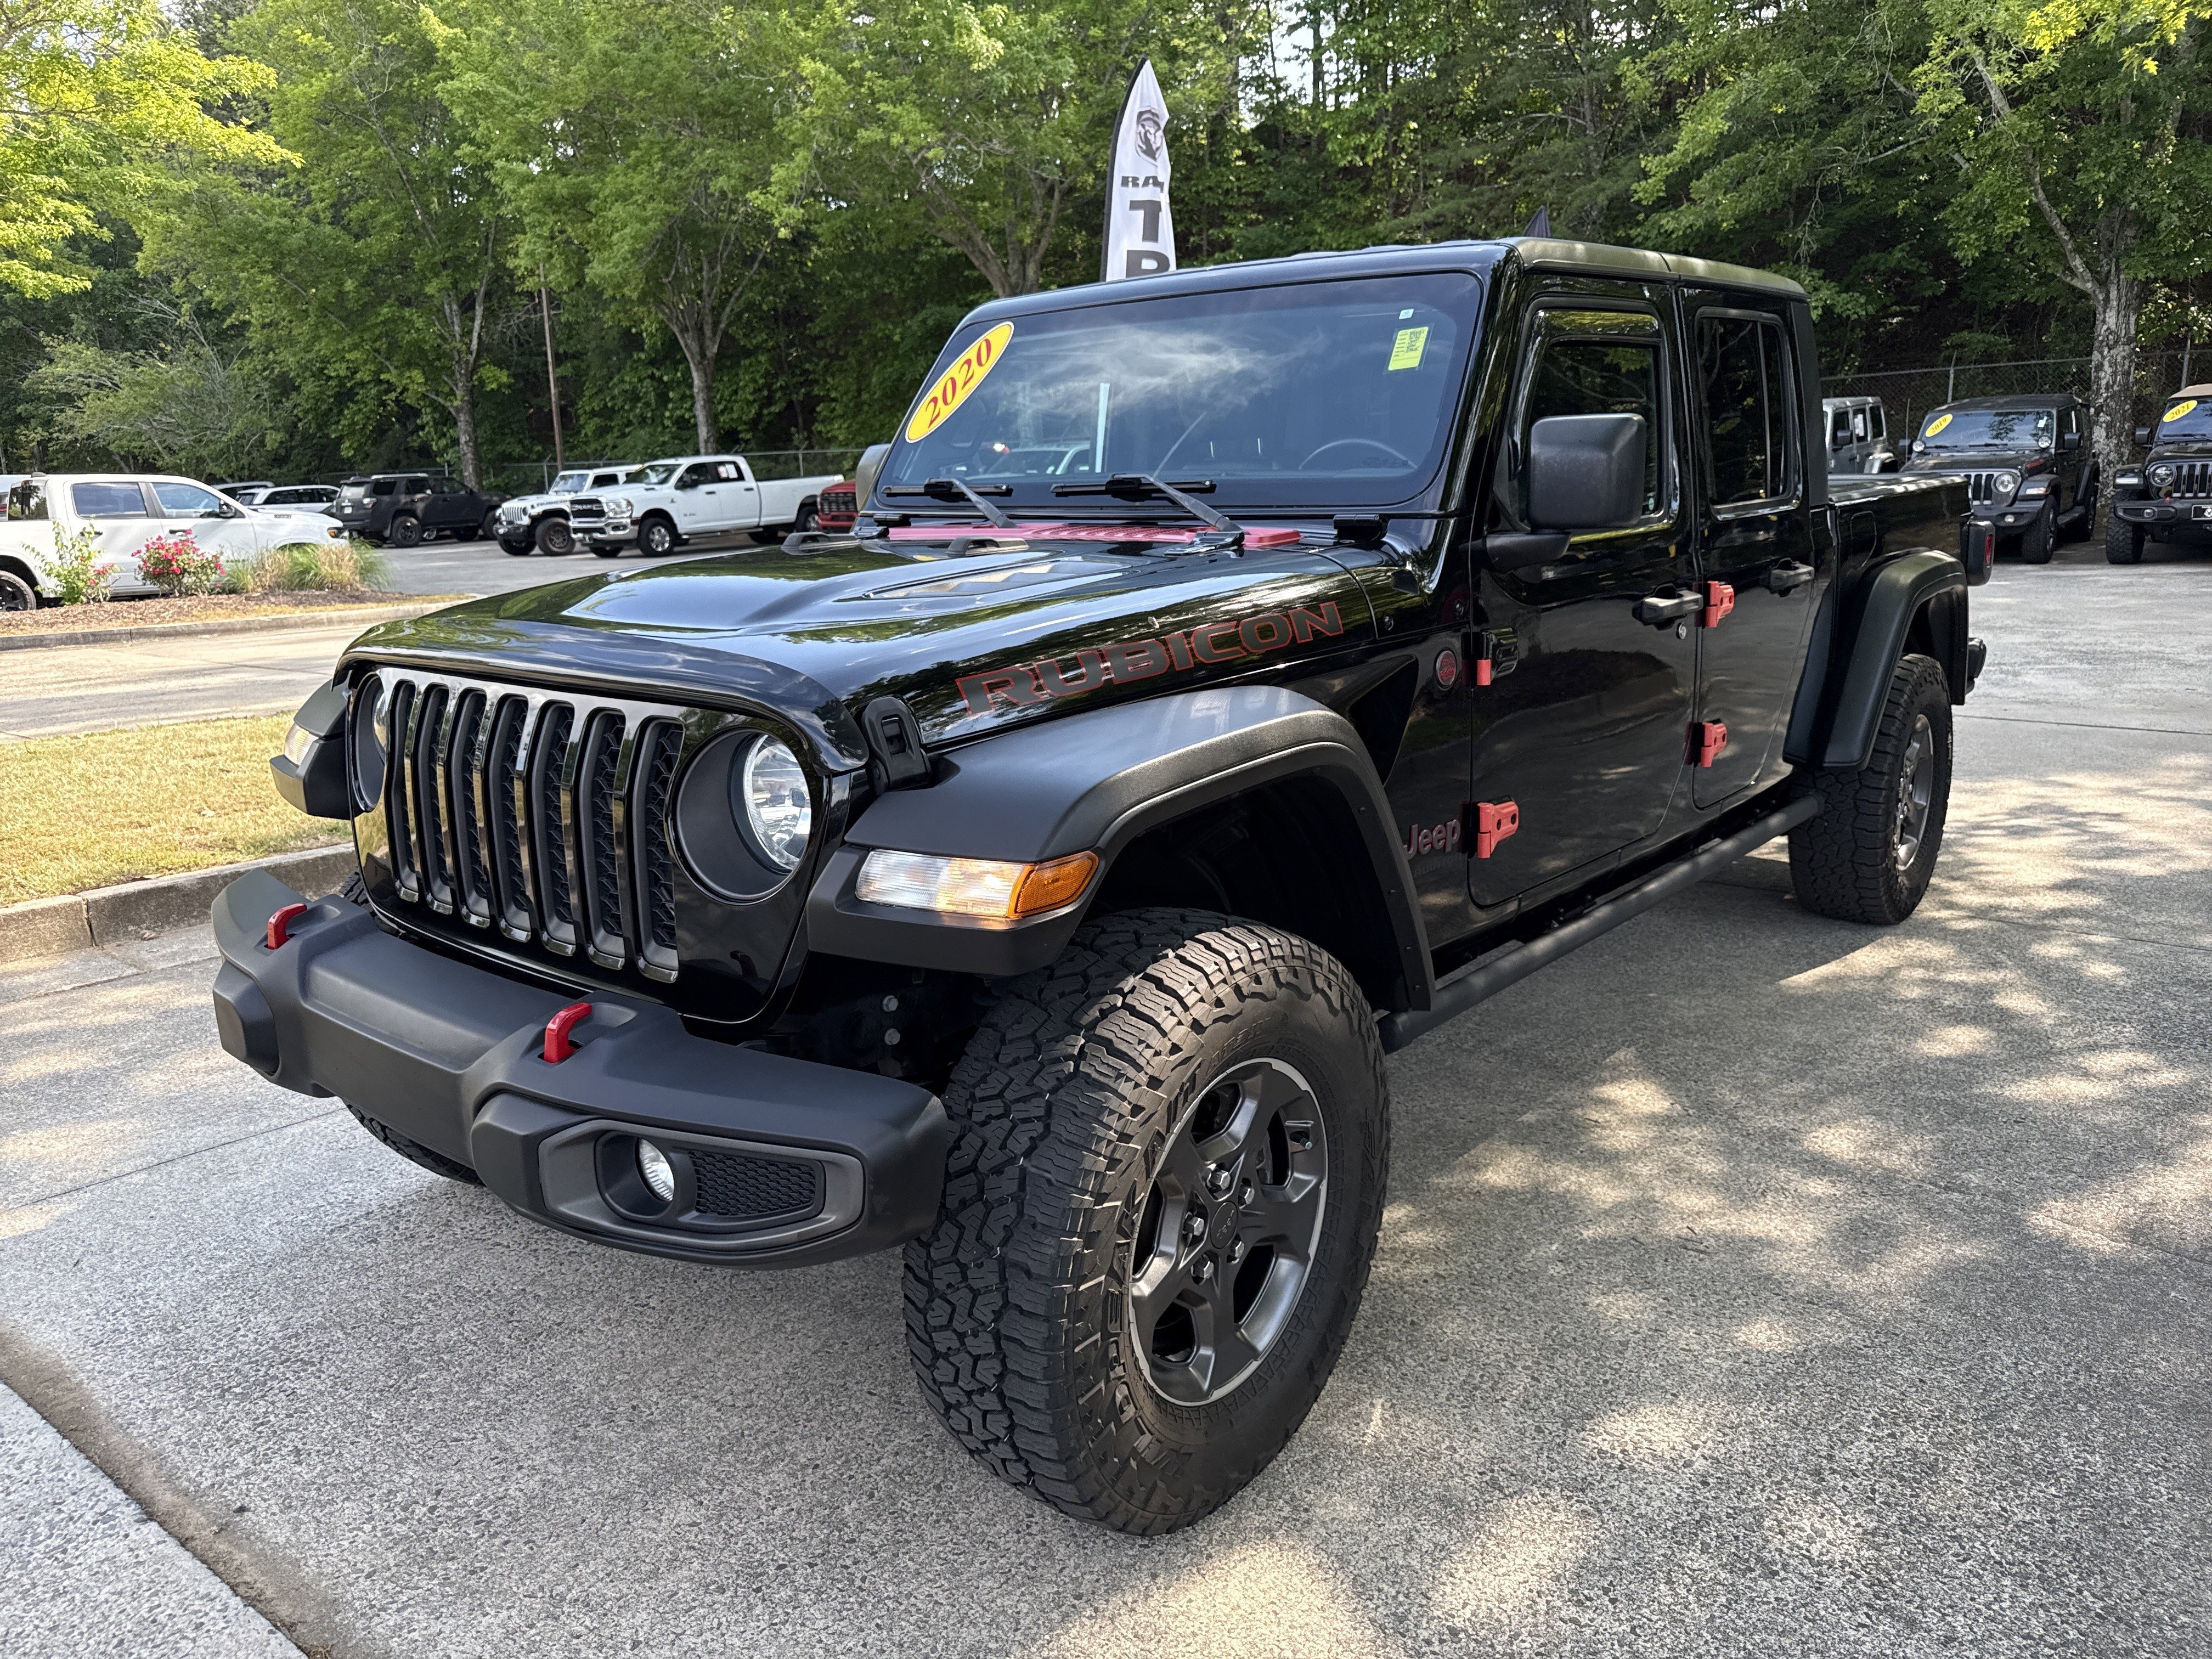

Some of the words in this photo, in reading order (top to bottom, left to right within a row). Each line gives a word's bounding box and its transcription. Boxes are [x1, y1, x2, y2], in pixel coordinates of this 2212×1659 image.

[925, 338, 991, 429] 2020
[2170, 403, 2190, 420] 2021
[955, 601, 1344, 716] RUBICON
[1403, 819, 1461, 860] Jeep
